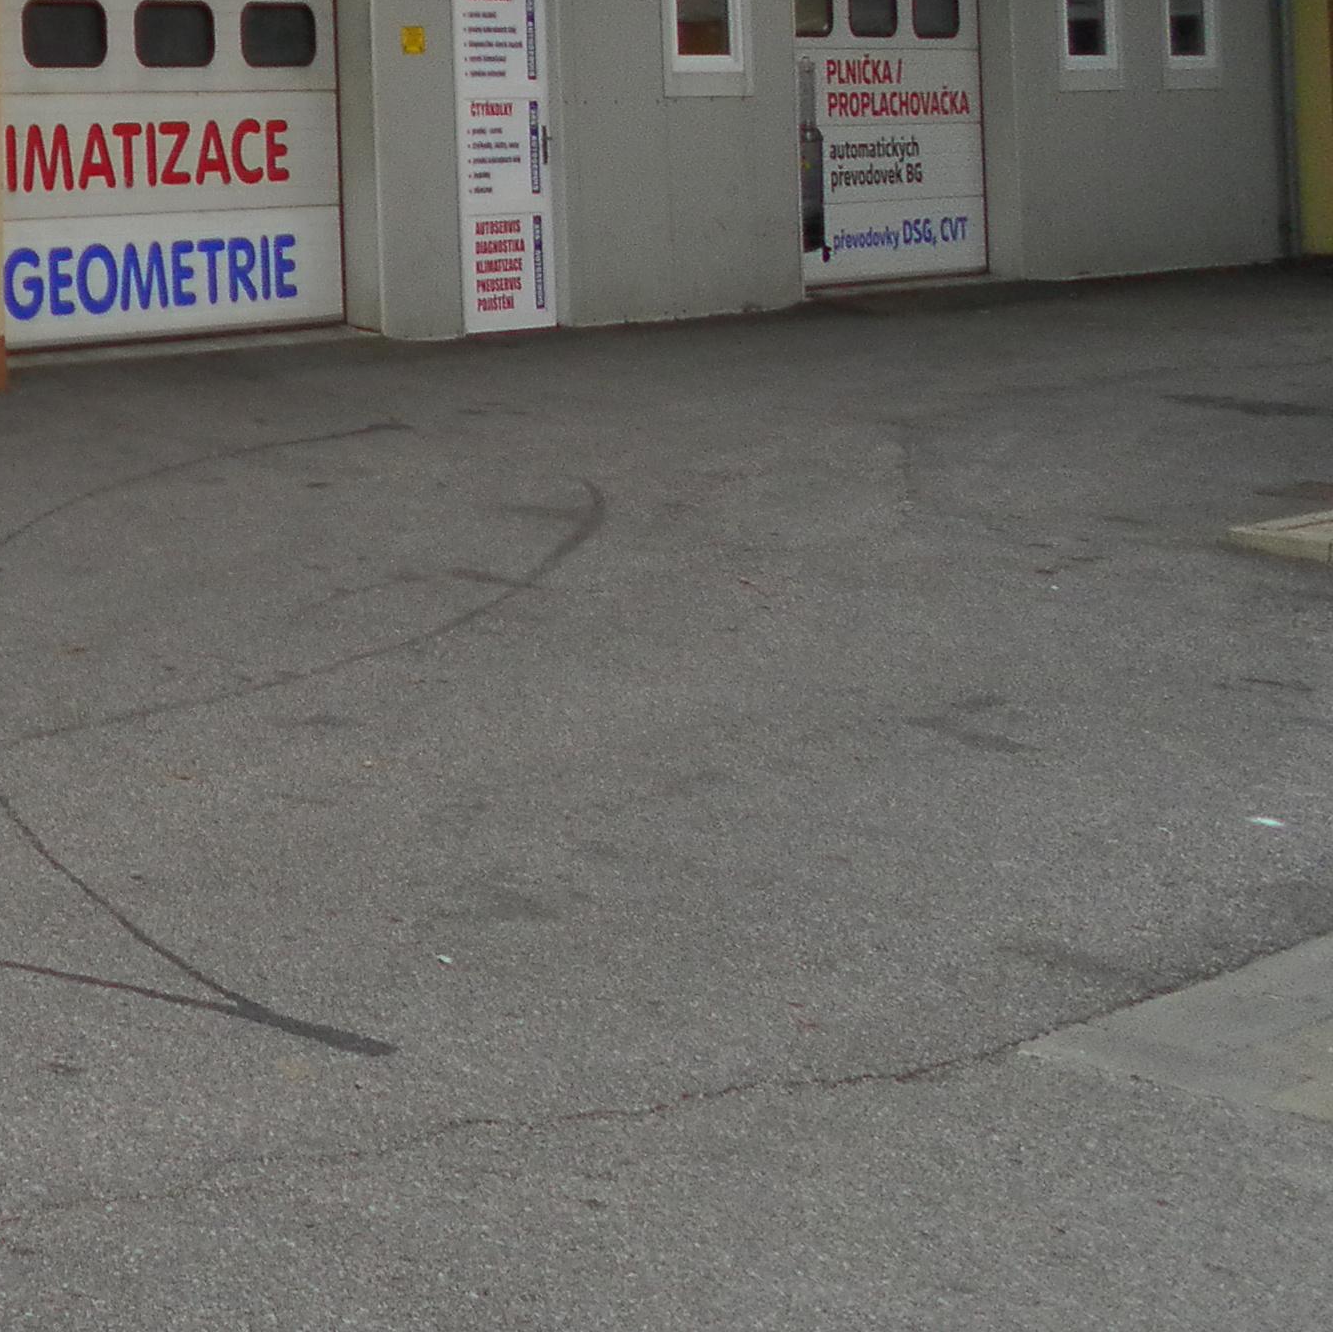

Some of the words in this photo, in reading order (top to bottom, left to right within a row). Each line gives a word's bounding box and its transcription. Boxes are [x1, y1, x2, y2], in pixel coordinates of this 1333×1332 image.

[826, 54, 893, 85] PLNIČKA
[827, 85, 970, 117] PROPLACHOVAČKA
[829, 136, 920, 163] automatických
[830, 164, 903, 193] převodovek
[905, 162, 923, 184] BG
[475, 219, 521, 236] AUTOSERVIS
[833, 226, 900, 255] převodovky
[940, 216, 968, 242] CVT
[475, 238, 525, 255] DIAGNOSTIKA
[2, 233, 298, 321] GEOMETRIE
[476, 277, 522, 293] PNEUSERVIS
